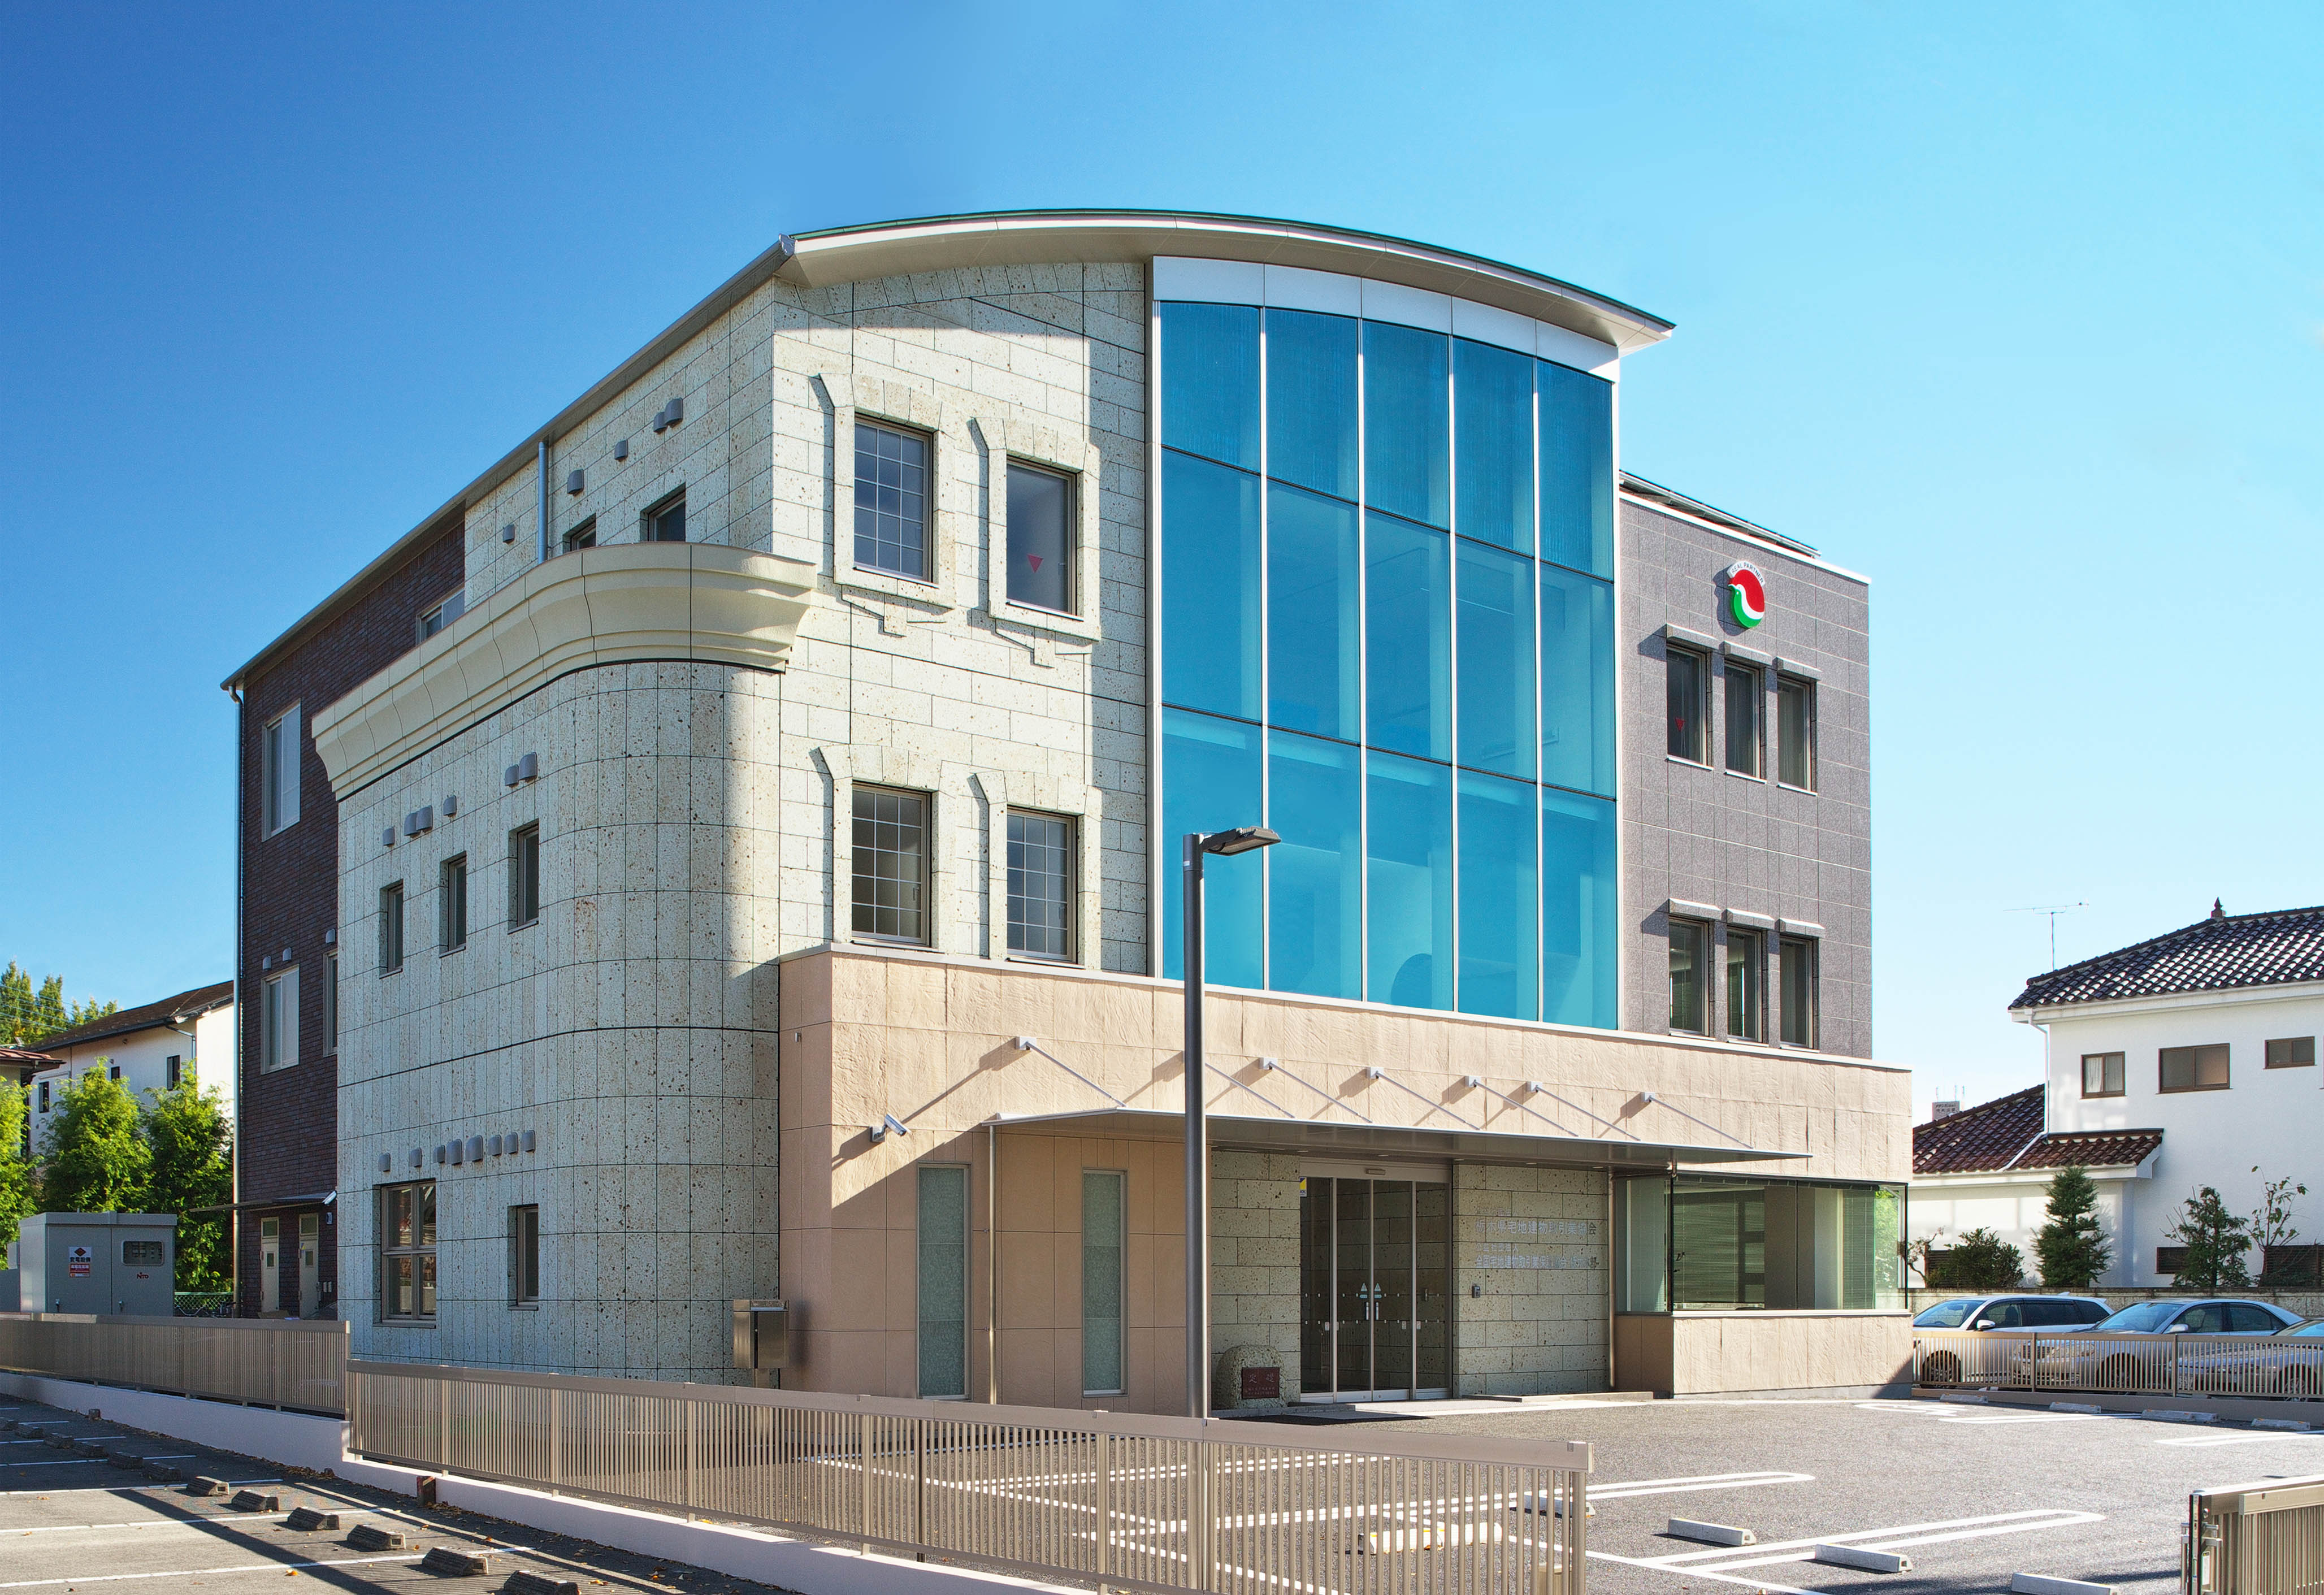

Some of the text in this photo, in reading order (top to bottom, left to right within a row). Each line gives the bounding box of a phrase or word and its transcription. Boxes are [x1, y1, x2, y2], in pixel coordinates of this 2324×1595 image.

[1731, 562, 1764, 583] REAL PARTNER
[1475, 1220, 1597, 1235] 栃木県宅地建物取引業協会
